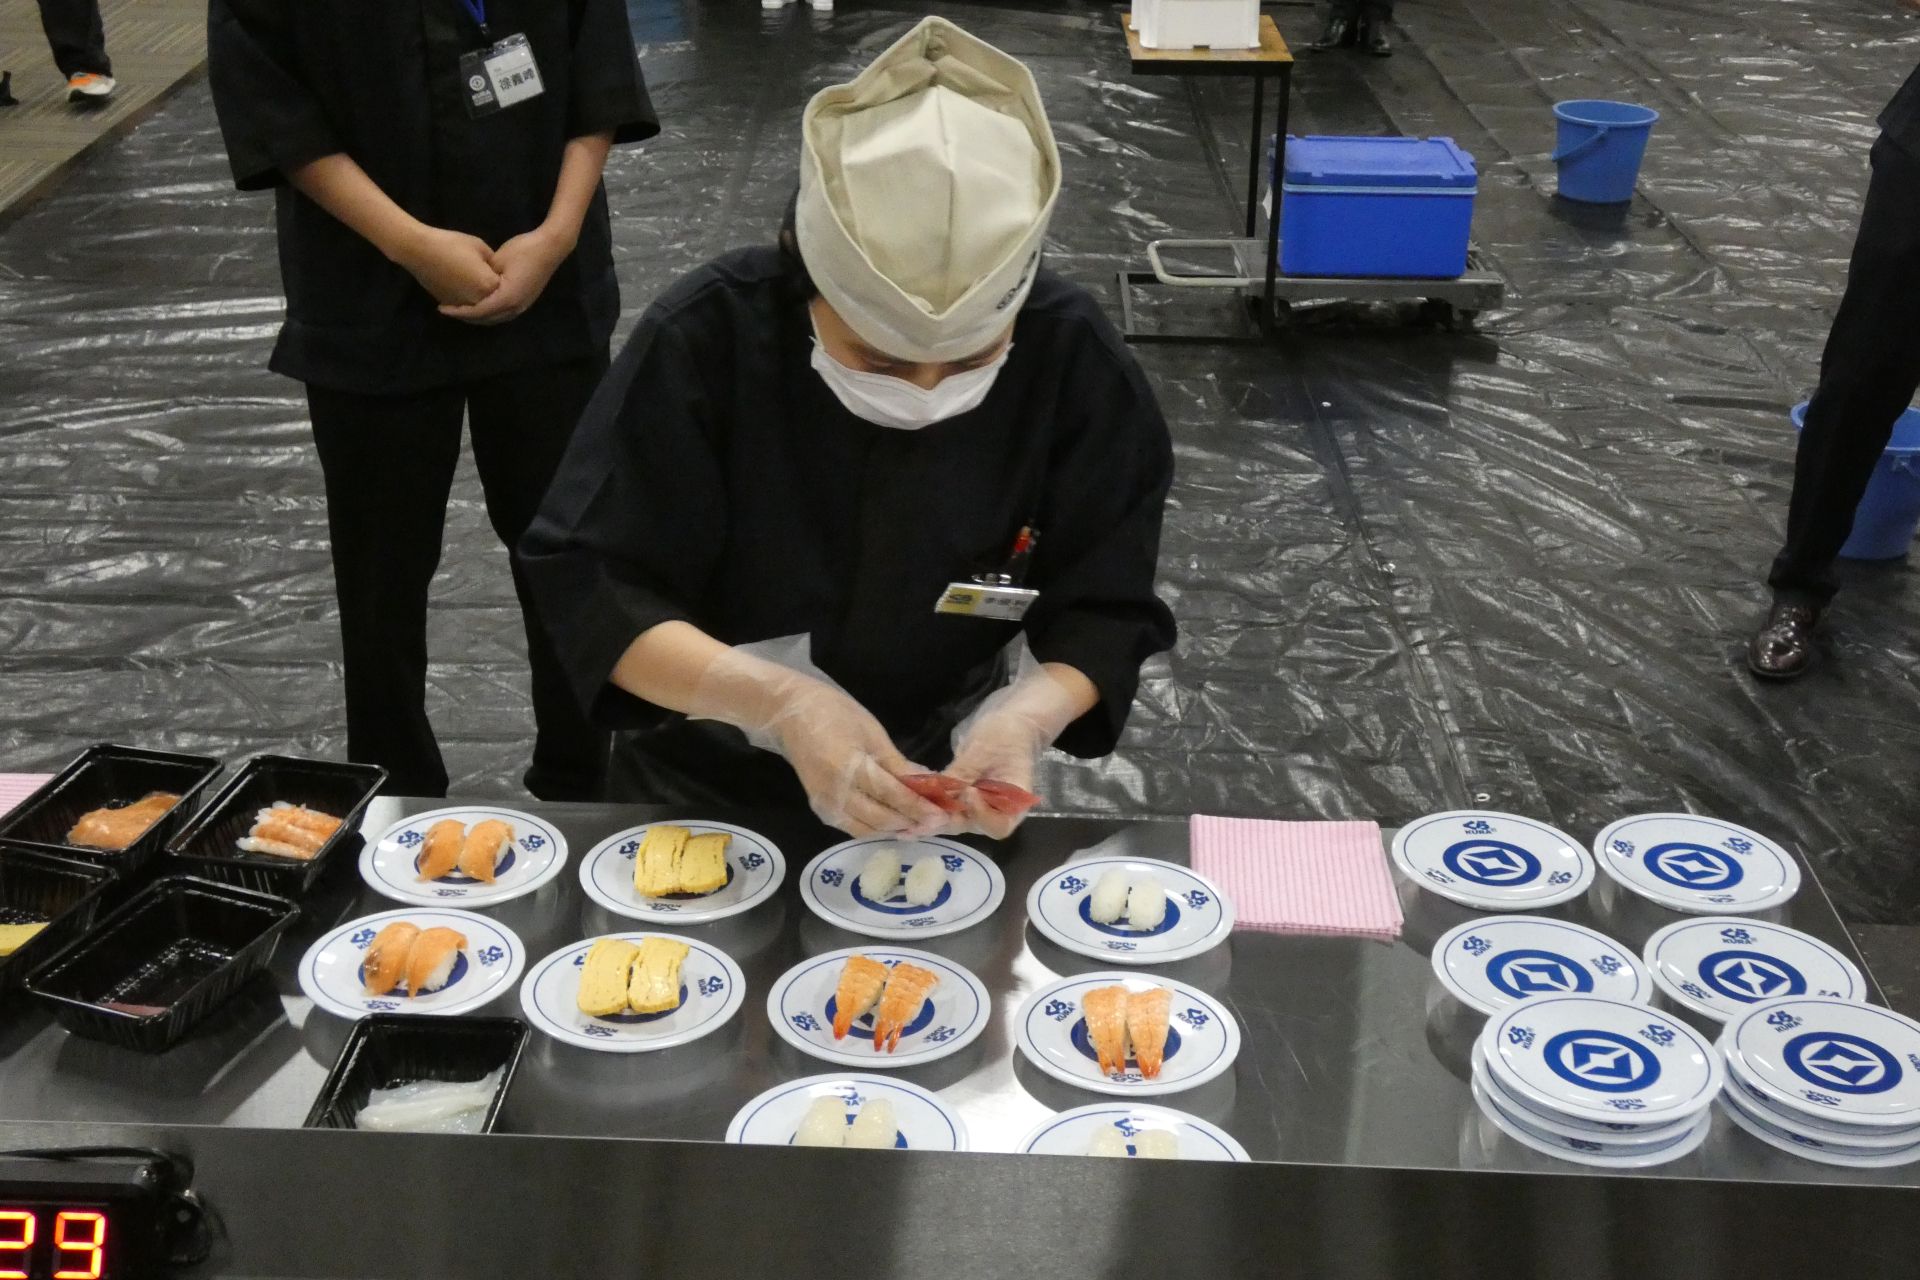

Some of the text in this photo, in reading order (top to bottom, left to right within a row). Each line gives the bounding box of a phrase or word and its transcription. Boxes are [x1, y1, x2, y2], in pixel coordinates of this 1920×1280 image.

[1463, 820, 1490, 830] くら
[397, 830, 420, 845] くら
[528, 834, 546, 849] くら
[1728, 836, 1753, 850] くら
[1613, 839, 1628, 853] くら
[1721, 841, 1746, 855] KURA
[748, 853, 765, 867] くら
[941, 854, 965, 868] くら
[820, 869, 837, 885] くら
[1059, 876, 1081, 891] くら
[1067, 882, 1088, 896] KURA
[1191, 889, 1209, 906] くら
[1720, 928, 1750, 939] くら
[1463, 935, 1484, 950] くら
[1471, 943, 1492, 957] KURA
[487, 945, 504, 962] くら
[1590, 957, 1609, 975] KURA
[708, 976, 724, 993] くら
[1045, 999, 1067, 1016] くら
[1055, 1006, 1075, 1022] KURA
[790, 1014, 811, 1031] くら
[806, 1014, 822, 1031] KURA
[1187, 1008, 1210, 1025] くら
[1767, 1010, 1794, 1025] くら
[927, 1025, 948, 1041] KURA
[1648, 1023, 1676, 1042] くら
[1774, 1021, 1802, 1033] KURA
[932, 1028, 956, 1042] くら
[1507, 1026, 1527, 1045] くら
[1521, 1032, 1536, 1050] KURA
[1638, 1029, 1668, 1047] KURA
[0, 1211, 106, 1280] 29
